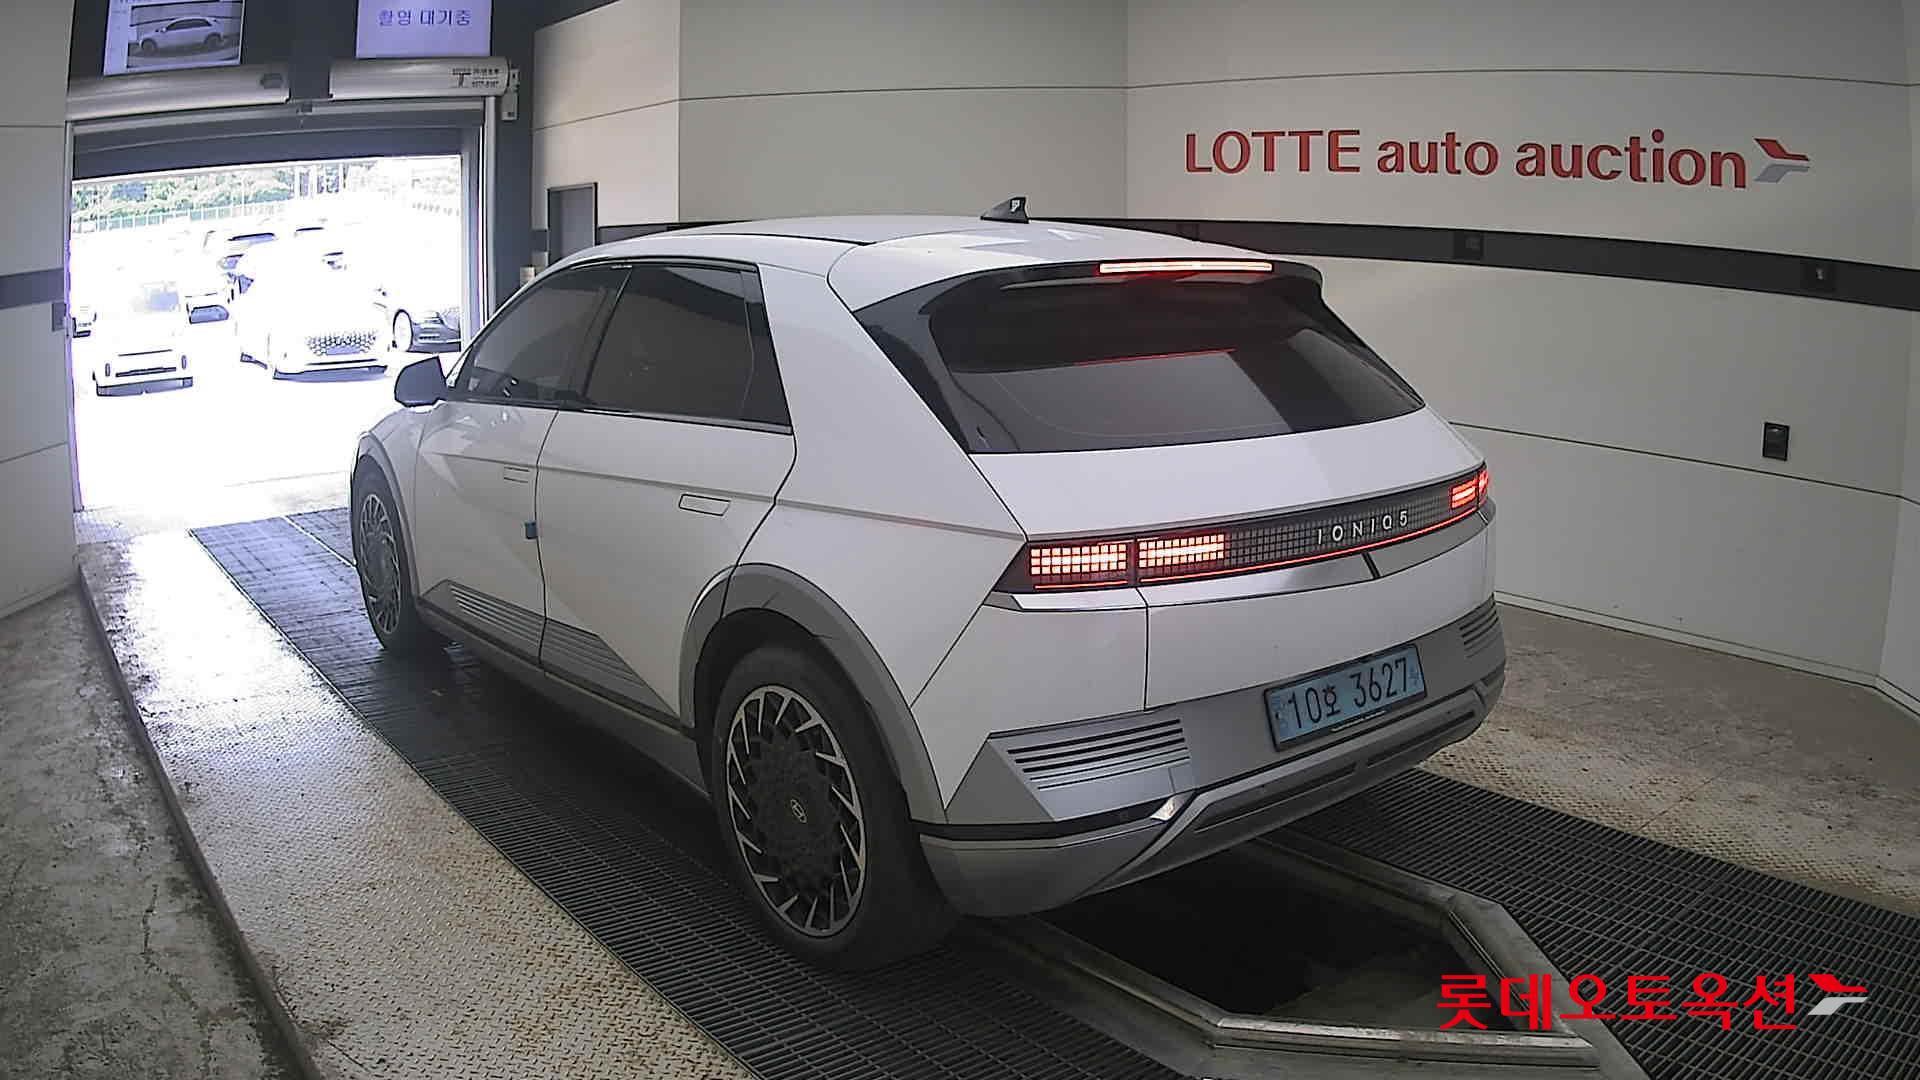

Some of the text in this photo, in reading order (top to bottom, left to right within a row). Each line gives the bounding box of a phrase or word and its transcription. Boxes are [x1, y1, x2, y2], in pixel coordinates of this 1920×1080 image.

[420, 9, 472, 26] 대기중
[1185, 129, 1747, 189] LOTTE auto auction
[1287, 656, 1407, 729] 10호 3627
